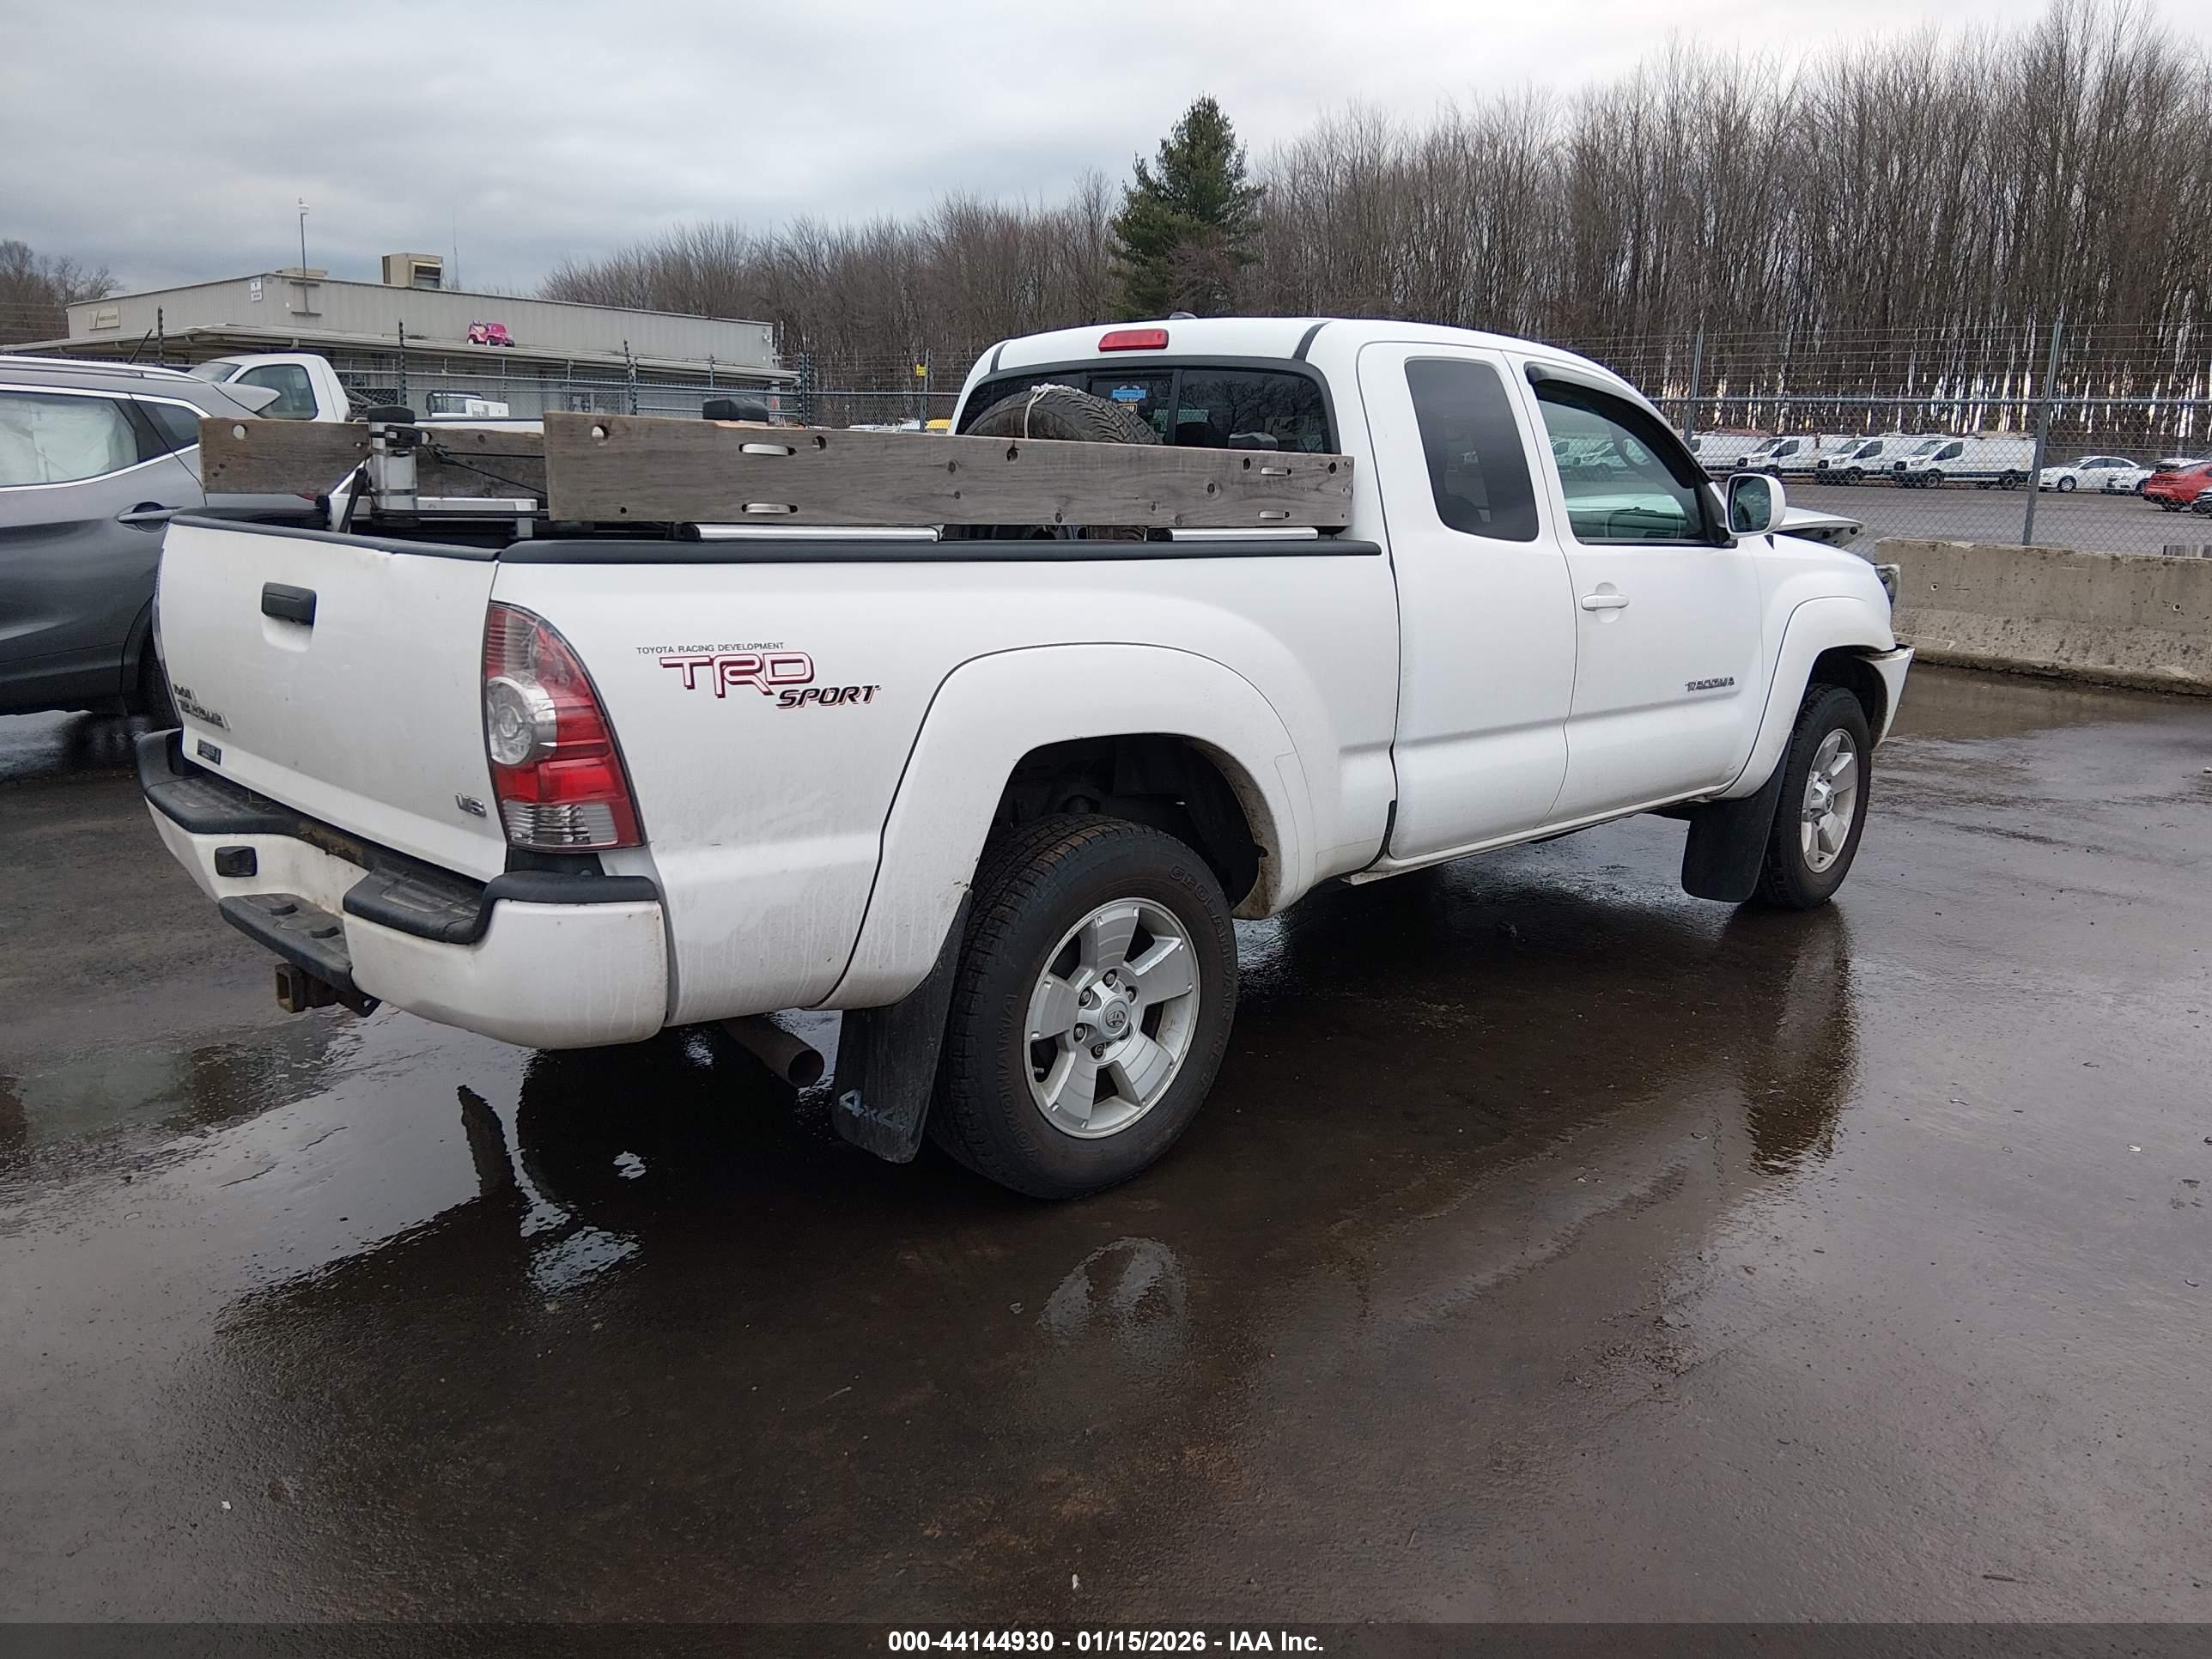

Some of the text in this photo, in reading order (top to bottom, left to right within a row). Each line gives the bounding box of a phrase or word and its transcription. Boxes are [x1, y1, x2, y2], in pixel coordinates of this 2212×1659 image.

[636, 641, 785, 655] TOYOTA RACING DEVELOPMENT
[659, 652, 816, 699] TRD
[775, 684, 881, 710] SPORT
[454, 792, 487, 817] V6
